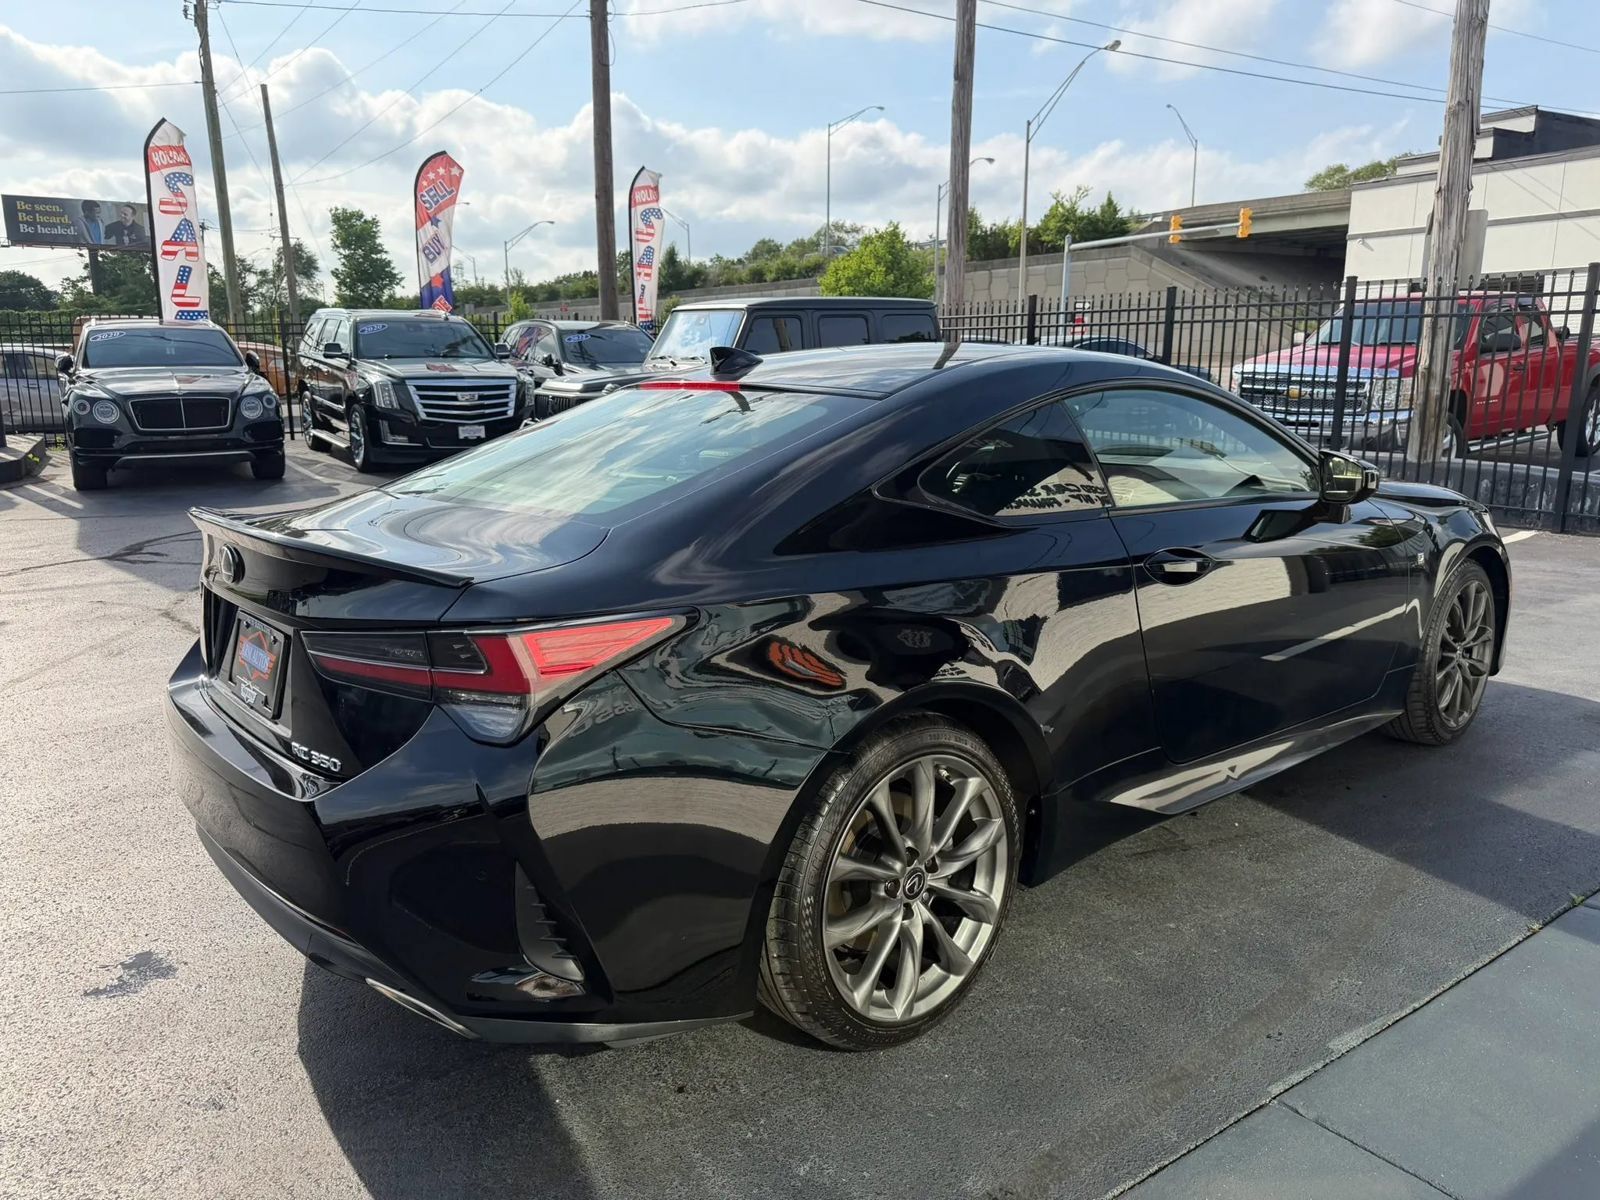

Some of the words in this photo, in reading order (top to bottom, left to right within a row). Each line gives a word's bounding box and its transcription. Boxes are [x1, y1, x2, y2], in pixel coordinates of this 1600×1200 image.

[16, 200, 32, 210] Be
[34, 202, 64, 212] seen.
[419, 179, 455, 212] SELL
[18, 212, 33, 222] Be
[36, 213, 72, 224] heard.
[19, 224, 35, 233] Be
[38, 225, 78, 235] healed.
[422, 233, 445, 263] BUY
[291, 741, 310, 761] RC
[310, 750, 342, 773] 350
